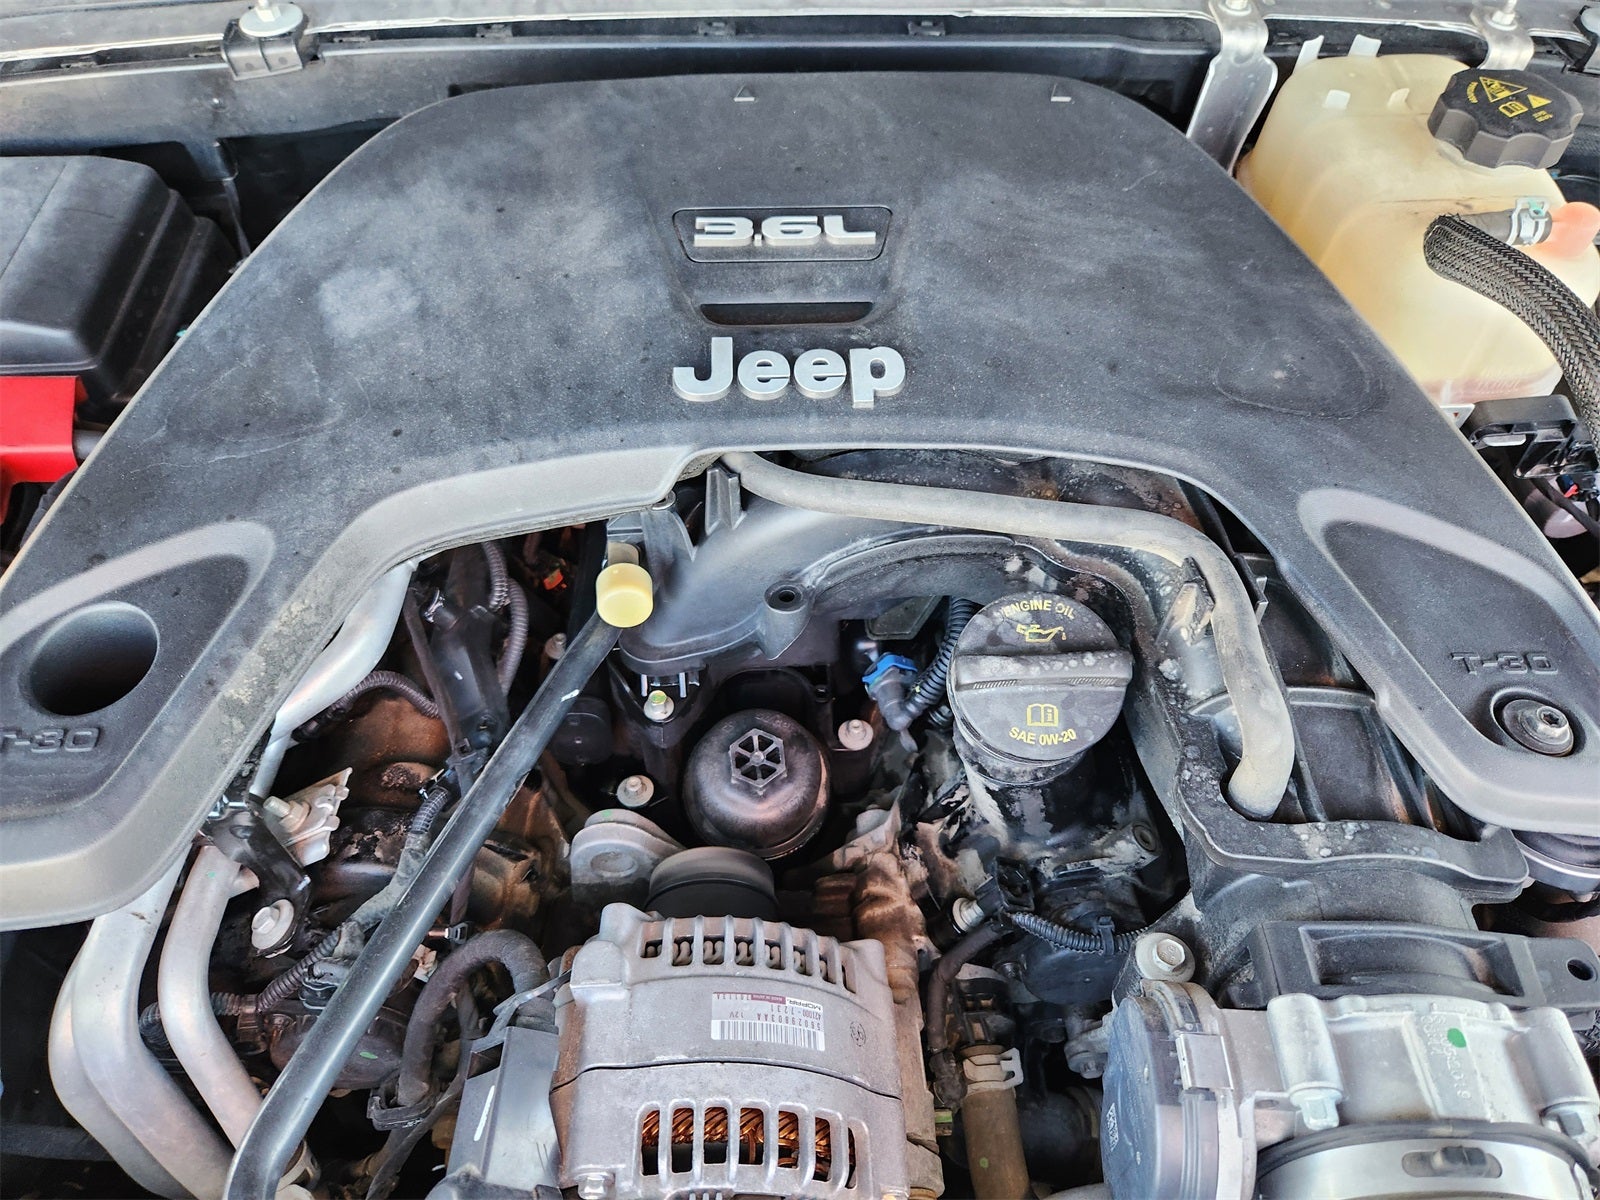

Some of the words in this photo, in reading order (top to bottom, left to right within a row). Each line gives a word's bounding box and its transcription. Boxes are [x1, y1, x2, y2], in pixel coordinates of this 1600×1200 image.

[693, 214, 877, 247] 3.6L
[672, 336, 906, 409] Jeep
[1002, 600, 1052, 618] ENGINE
[1054, 602, 1077, 620] OIL
[1450, 652, 1559, 676] T-30
[1008, 726, 1036, 745] SAE
[1038, 727, 1078, 746] 0W-20
